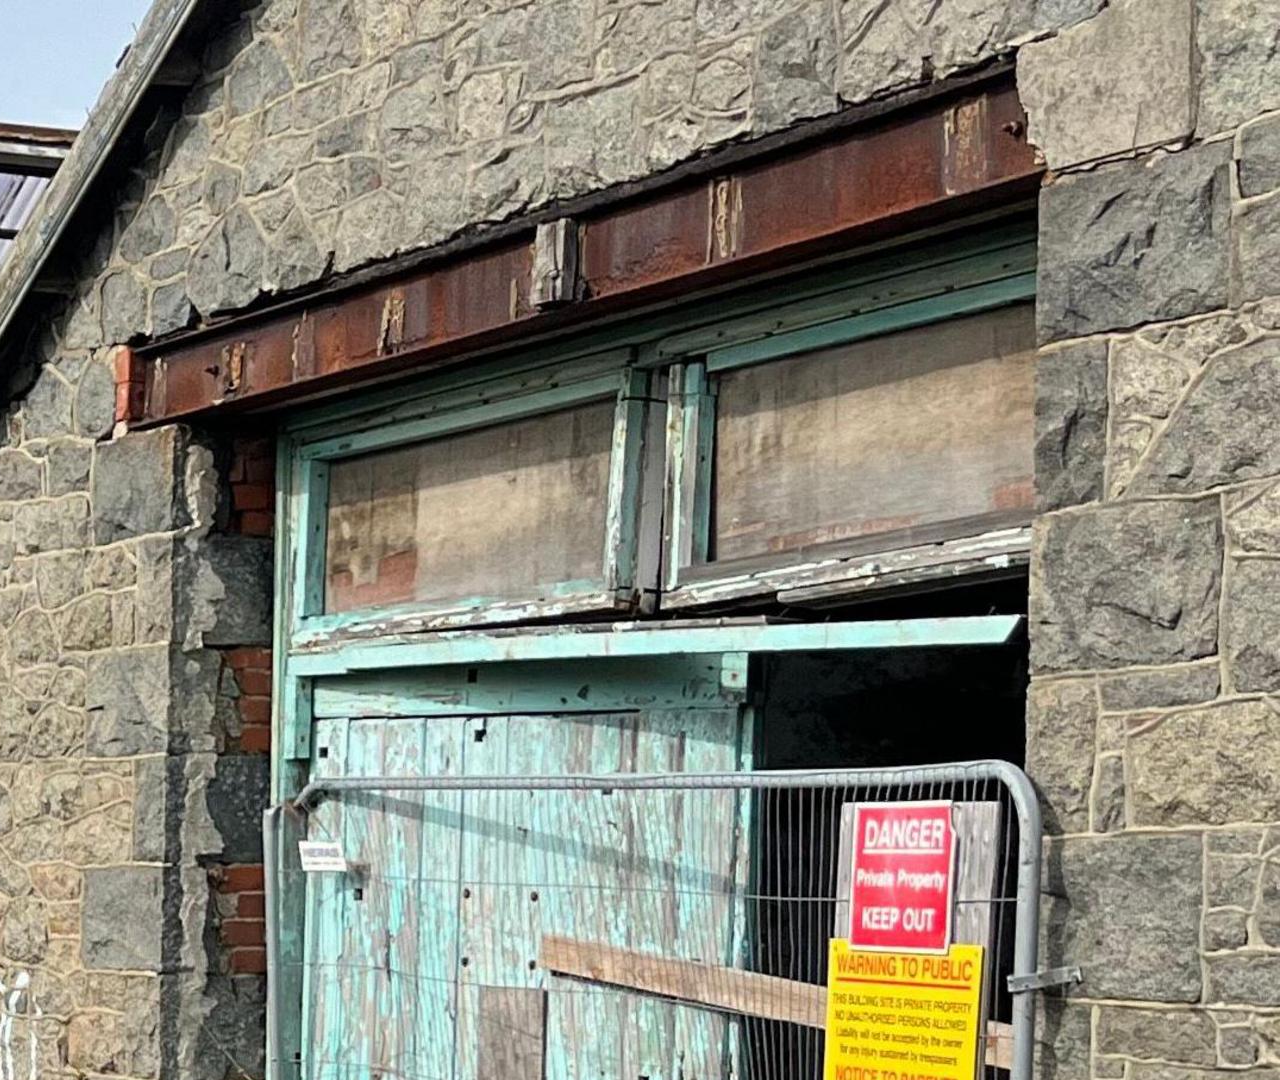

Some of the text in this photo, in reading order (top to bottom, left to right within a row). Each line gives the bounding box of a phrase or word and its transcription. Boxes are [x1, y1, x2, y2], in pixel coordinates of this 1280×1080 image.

[864, 819, 946, 848] DANGER
[856, 869, 946, 892] Private Property
[862, 906, 935, 932] KEEP OUT
[836, 954, 973, 981] WARNING TO PUBLIC
[833, 991, 971, 1014] THIS BUILDING SITE IS PRIVATE PROPERTY
[835, 1009, 844, 1020] NO
[898, 1014, 930, 1028] PERSONS
[933, 1018, 967, 1031] ALLOWED
